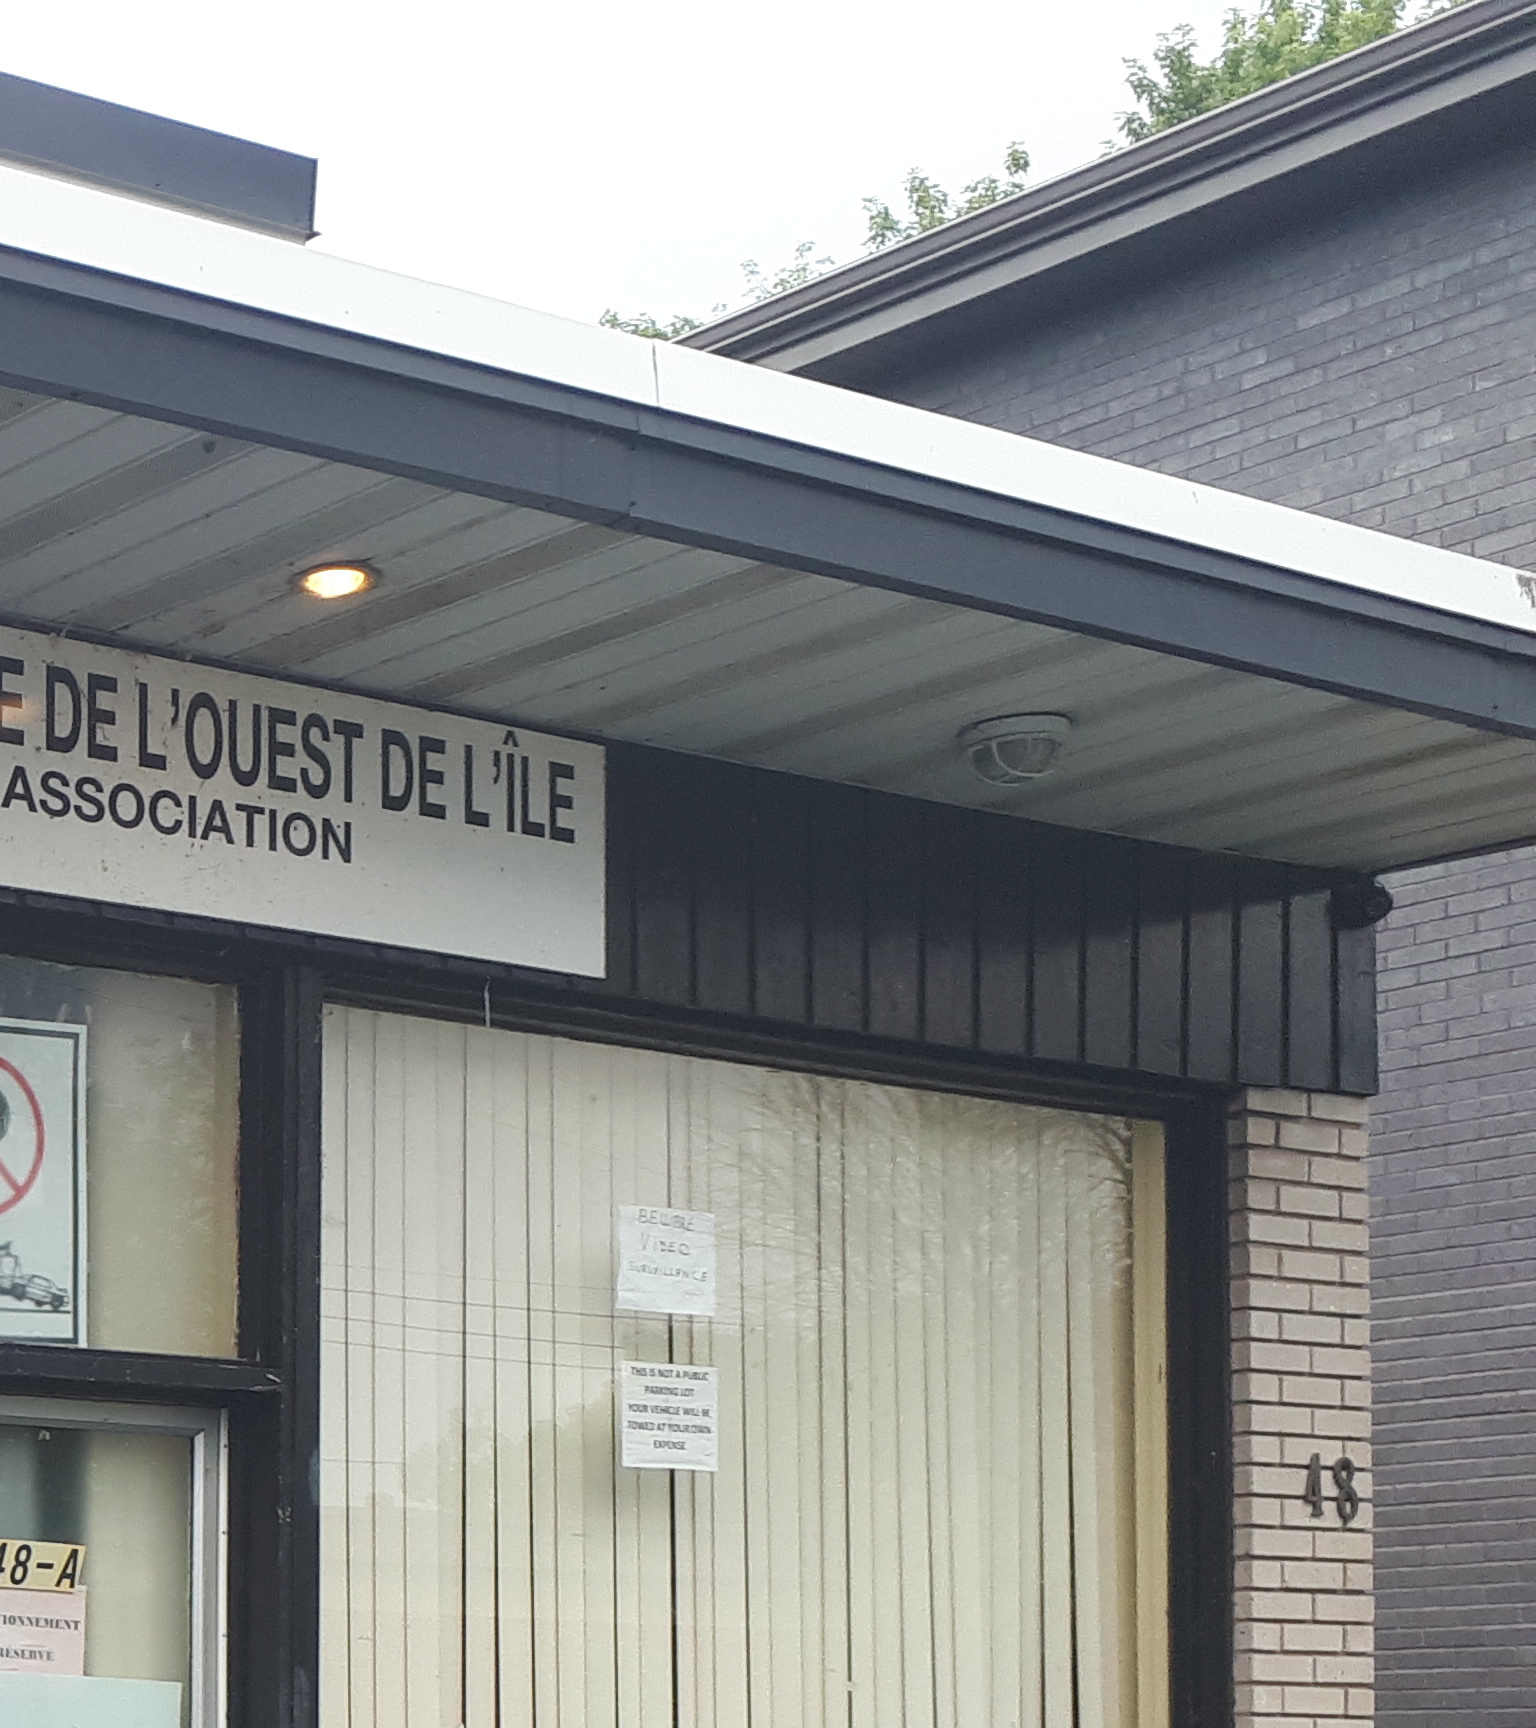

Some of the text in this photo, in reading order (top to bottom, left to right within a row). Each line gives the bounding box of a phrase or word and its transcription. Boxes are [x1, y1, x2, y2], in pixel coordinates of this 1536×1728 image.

[46, 667, 118, 762] DE
[138, 682, 363, 803] L'OUEST
[382, 730, 447, 820] DE
[464, 730, 576, 843] L'ÎLE
[2, 765, 353, 864] ASSOCIATION
[1304, 1453, 1359, 1522] 48
